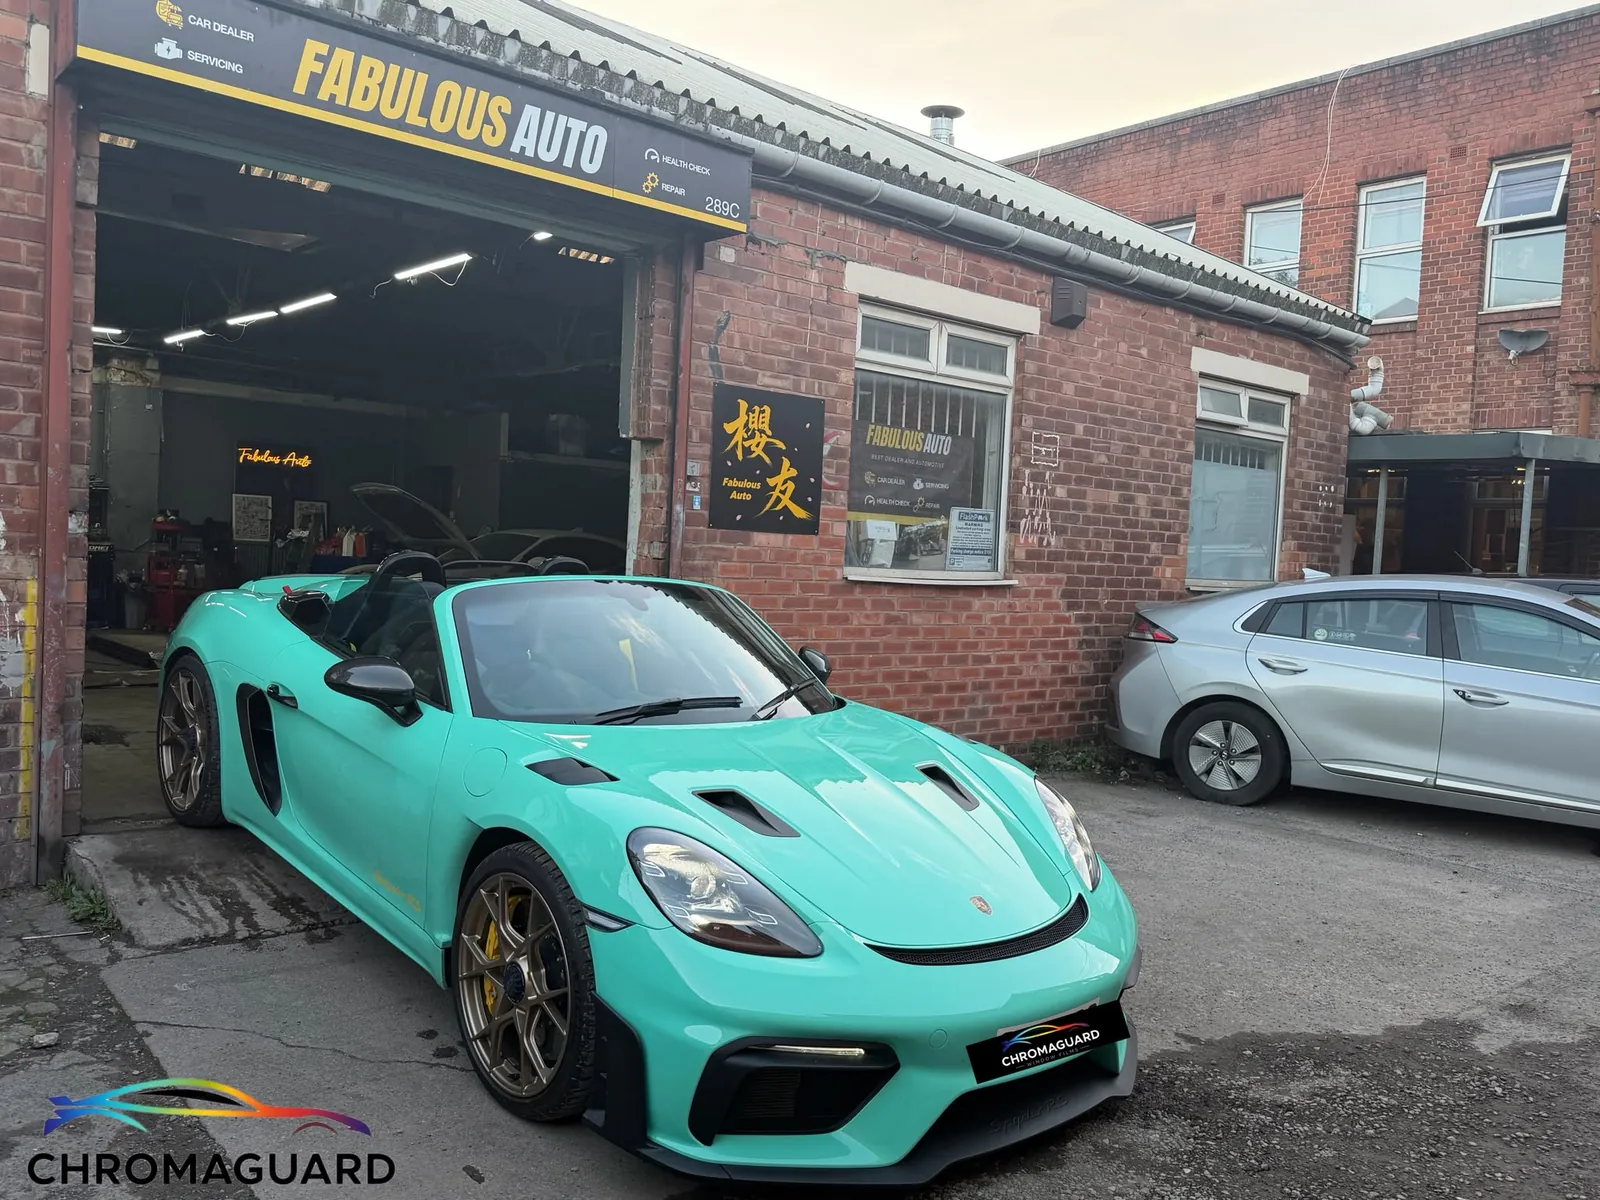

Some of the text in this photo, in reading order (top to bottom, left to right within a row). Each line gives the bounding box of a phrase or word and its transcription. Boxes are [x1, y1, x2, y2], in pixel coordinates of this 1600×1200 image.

[188, 15, 255, 43] CAR DEALER
[187, 50, 244, 74] SERVICING
[292, 38, 608, 175] FABULOUS AUTO
[661, 155, 711, 176] HEALTH CHECK
[661, 183, 686, 197] REPAIR
[705, 196, 740, 218] 289C
[865, 424, 953, 456] FABULOUS AUTO
[238, 447, 312, 468] Fabulous Auto
[884, 455, 904, 464] DEALER
[915, 459, 945, 468] AUTOMOTIVE
[722, 477, 762, 490] Fabulous
[925, 482, 949, 490] SERVICING
[730, 490, 752, 501] Auto
[876, 498, 911, 507] HEALTH CHECK
